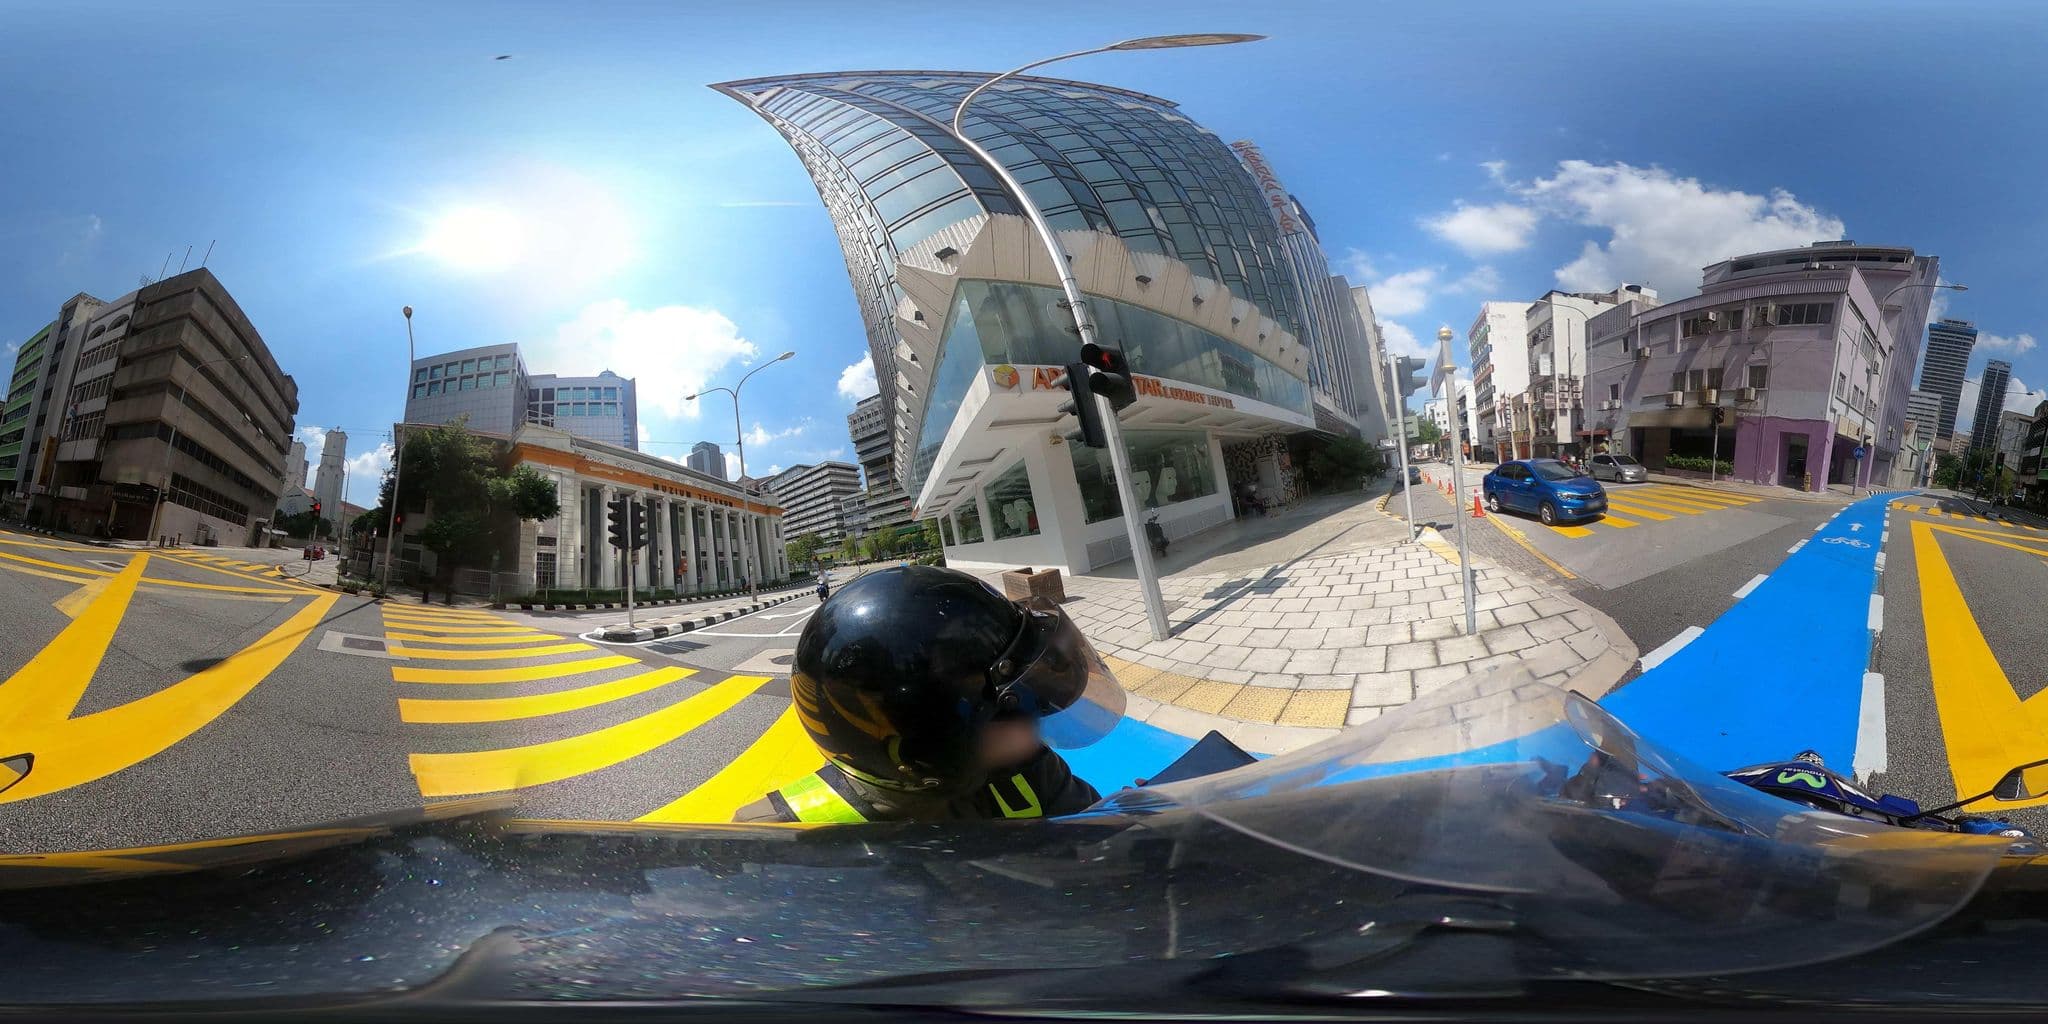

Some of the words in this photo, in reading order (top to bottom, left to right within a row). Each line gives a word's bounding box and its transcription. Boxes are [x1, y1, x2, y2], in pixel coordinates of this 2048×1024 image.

[1131, 375, 1164, 397] TAR
[653, 482, 692, 498] MUZIUM
[698, 493, 733, 507] TELEKOM
[1784, 767, 1826, 776] movistar
